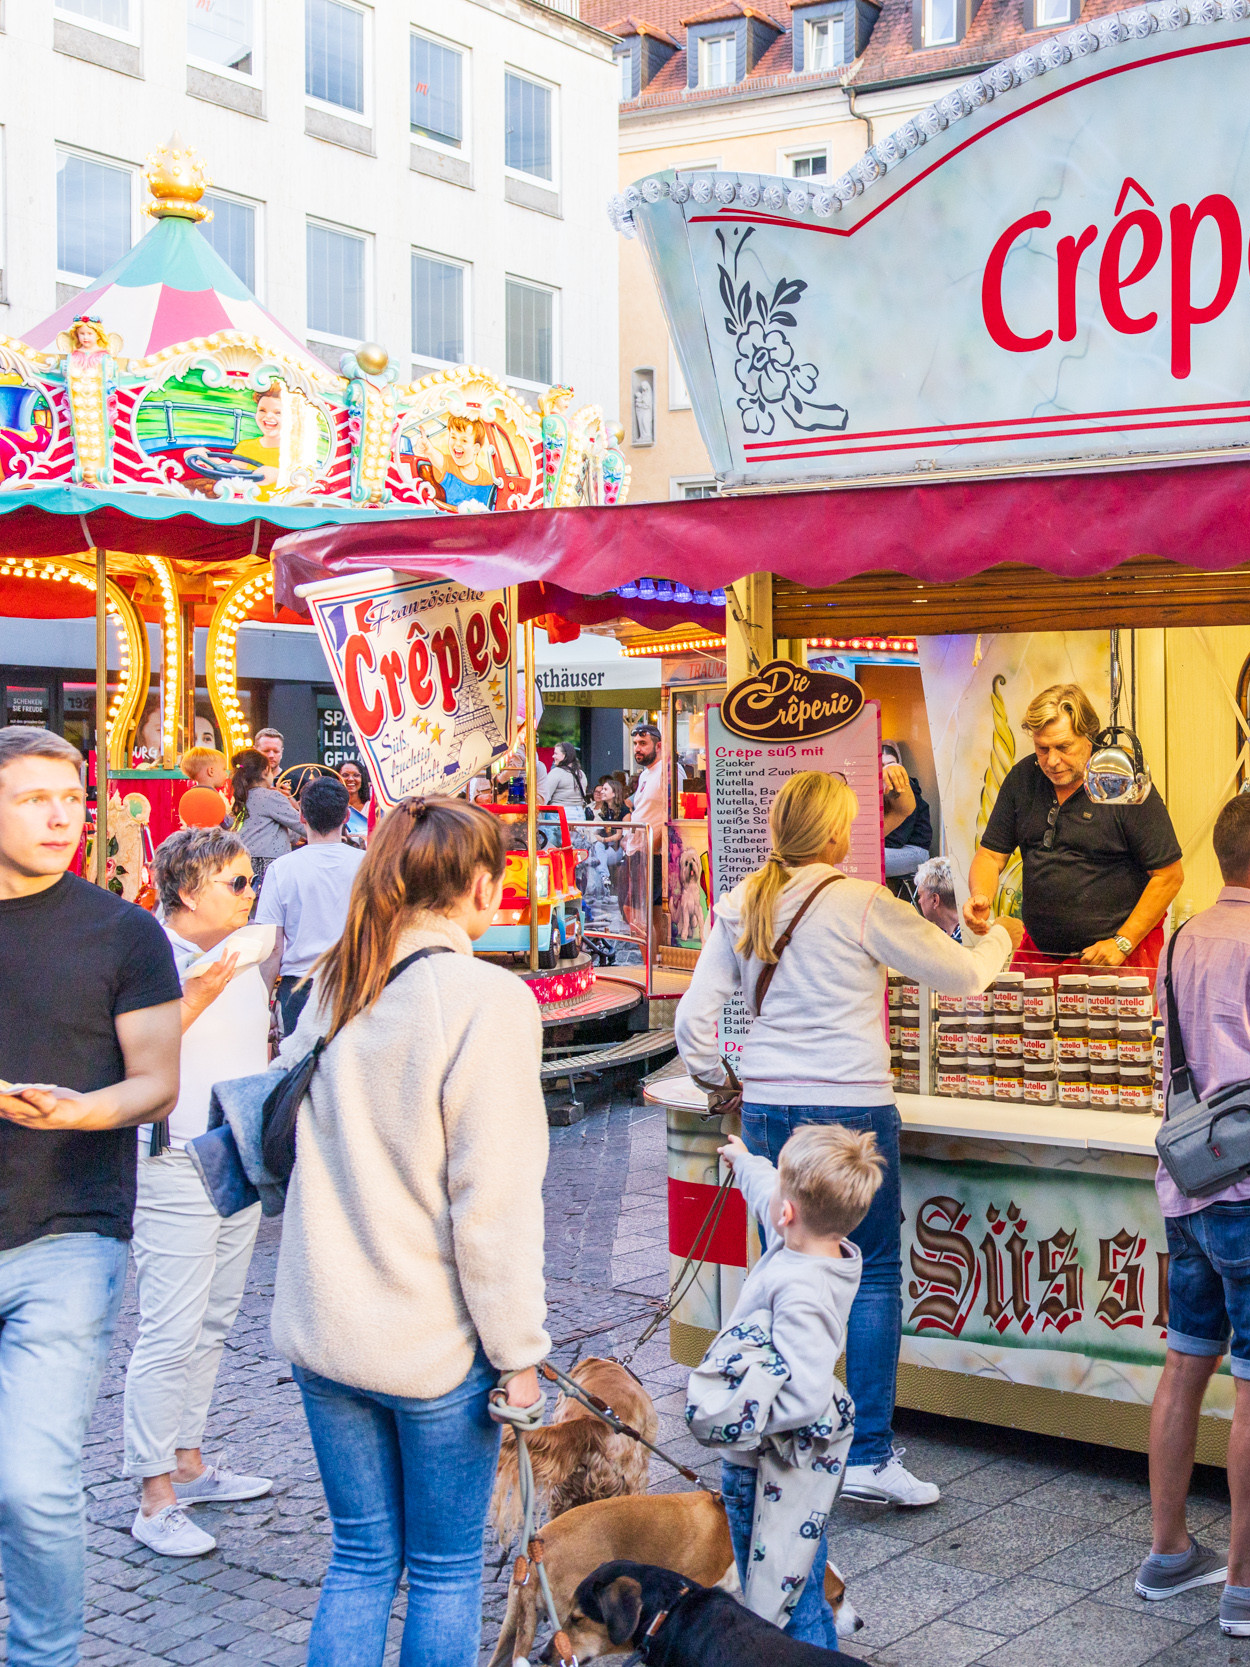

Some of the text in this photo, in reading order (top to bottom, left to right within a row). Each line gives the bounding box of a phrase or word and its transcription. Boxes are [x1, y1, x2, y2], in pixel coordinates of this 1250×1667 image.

[364, 587, 485, 636] Französische
[344, 601, 510, 739] Crêpes
[758, 666, 810, 697] Die
[730, 683, 853, 731] Crêperie
[715, 745, 824, 760] Crêpe süß mit
[715, 758, 755, 767] Zucker
[715, 768, 742, 777] Zimt
[745, 768, 765, 777] und
[716, 778, 754, 787] Nutella
[716, 788, 757, 797] Nutella,
[716, 797, 757, 806] Nutella,
[716, 807, 749, 816] weiße
[717, 816, 750, 825] weiße
[719, 855, 755, 865] Honig,
[1088, 996, 1115, 1005] nutella
[1061, 1085, 1085, 1093] nutella
